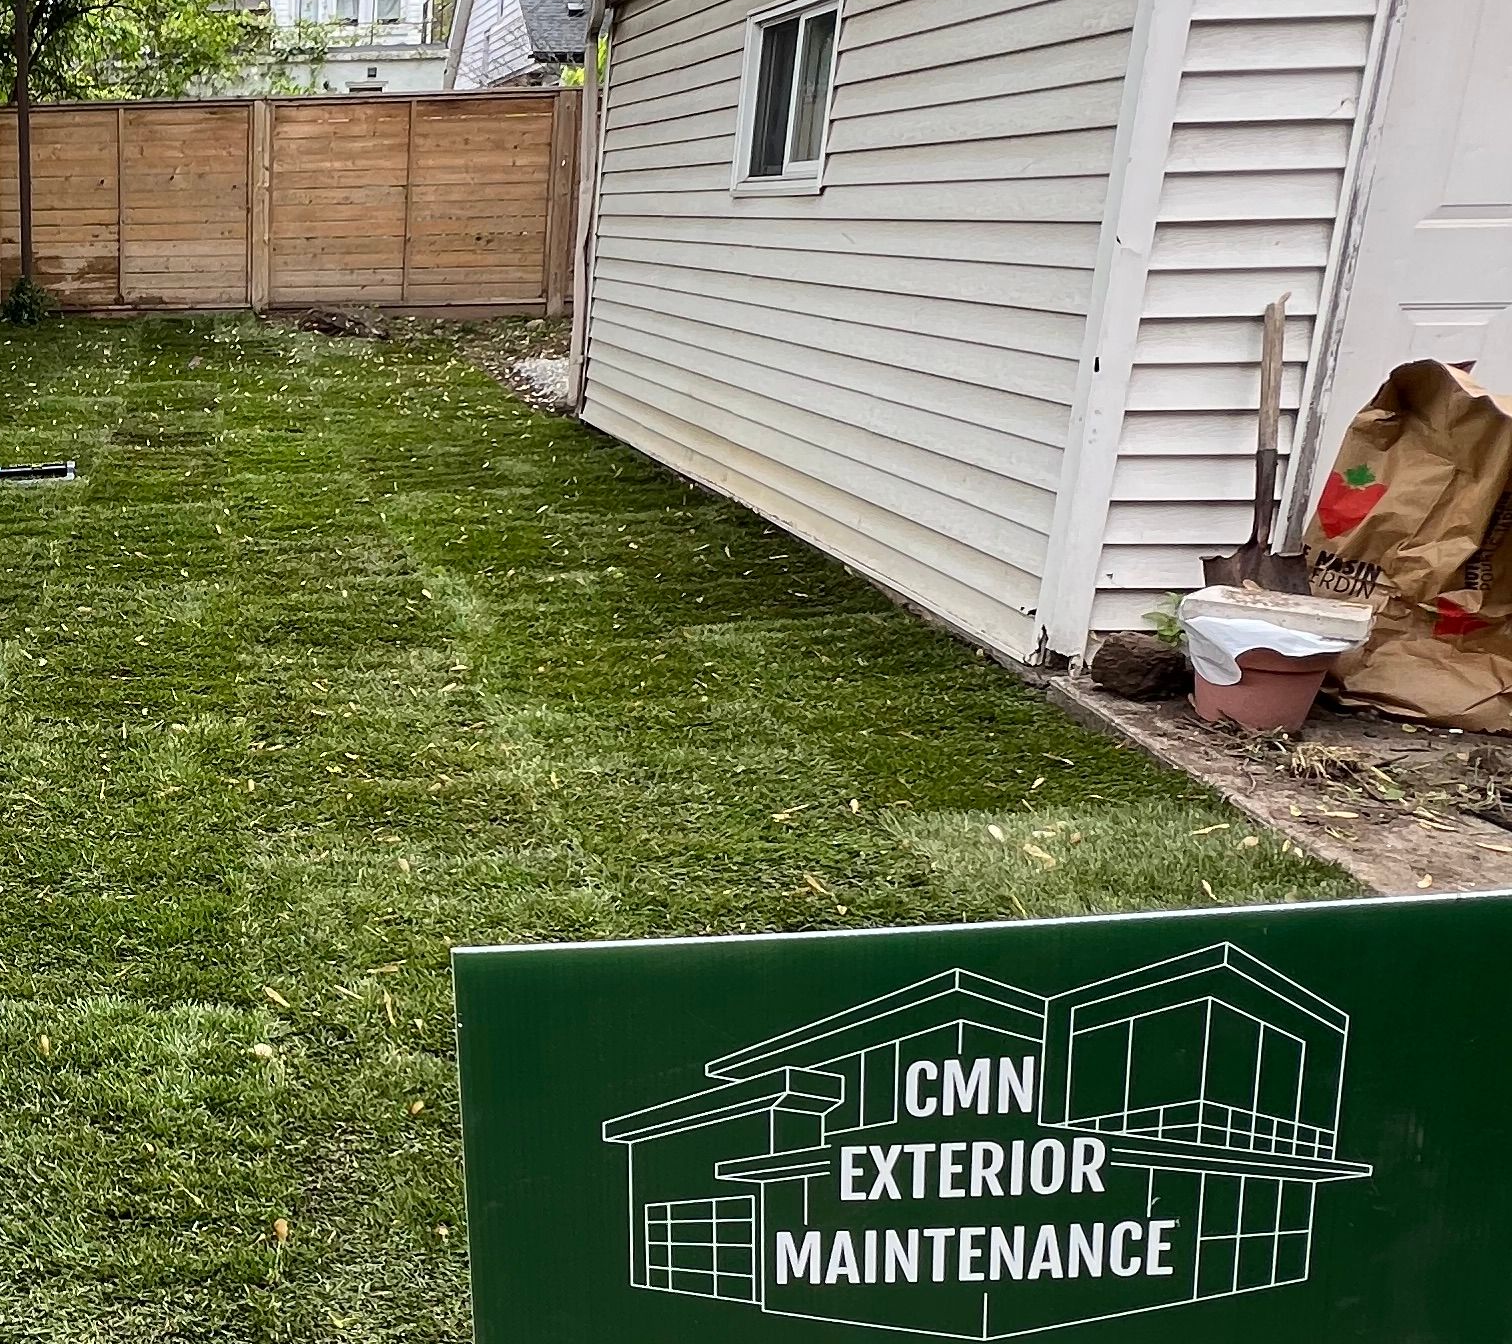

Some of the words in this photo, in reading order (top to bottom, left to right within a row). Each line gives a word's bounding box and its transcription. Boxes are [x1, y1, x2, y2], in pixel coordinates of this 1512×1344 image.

[905, 1056, 1036, 1118] CMN
[840, 1137, 1107, 1201] EXTERIOR
[776, 1219, 1176, 1285] MAINTENANCE
